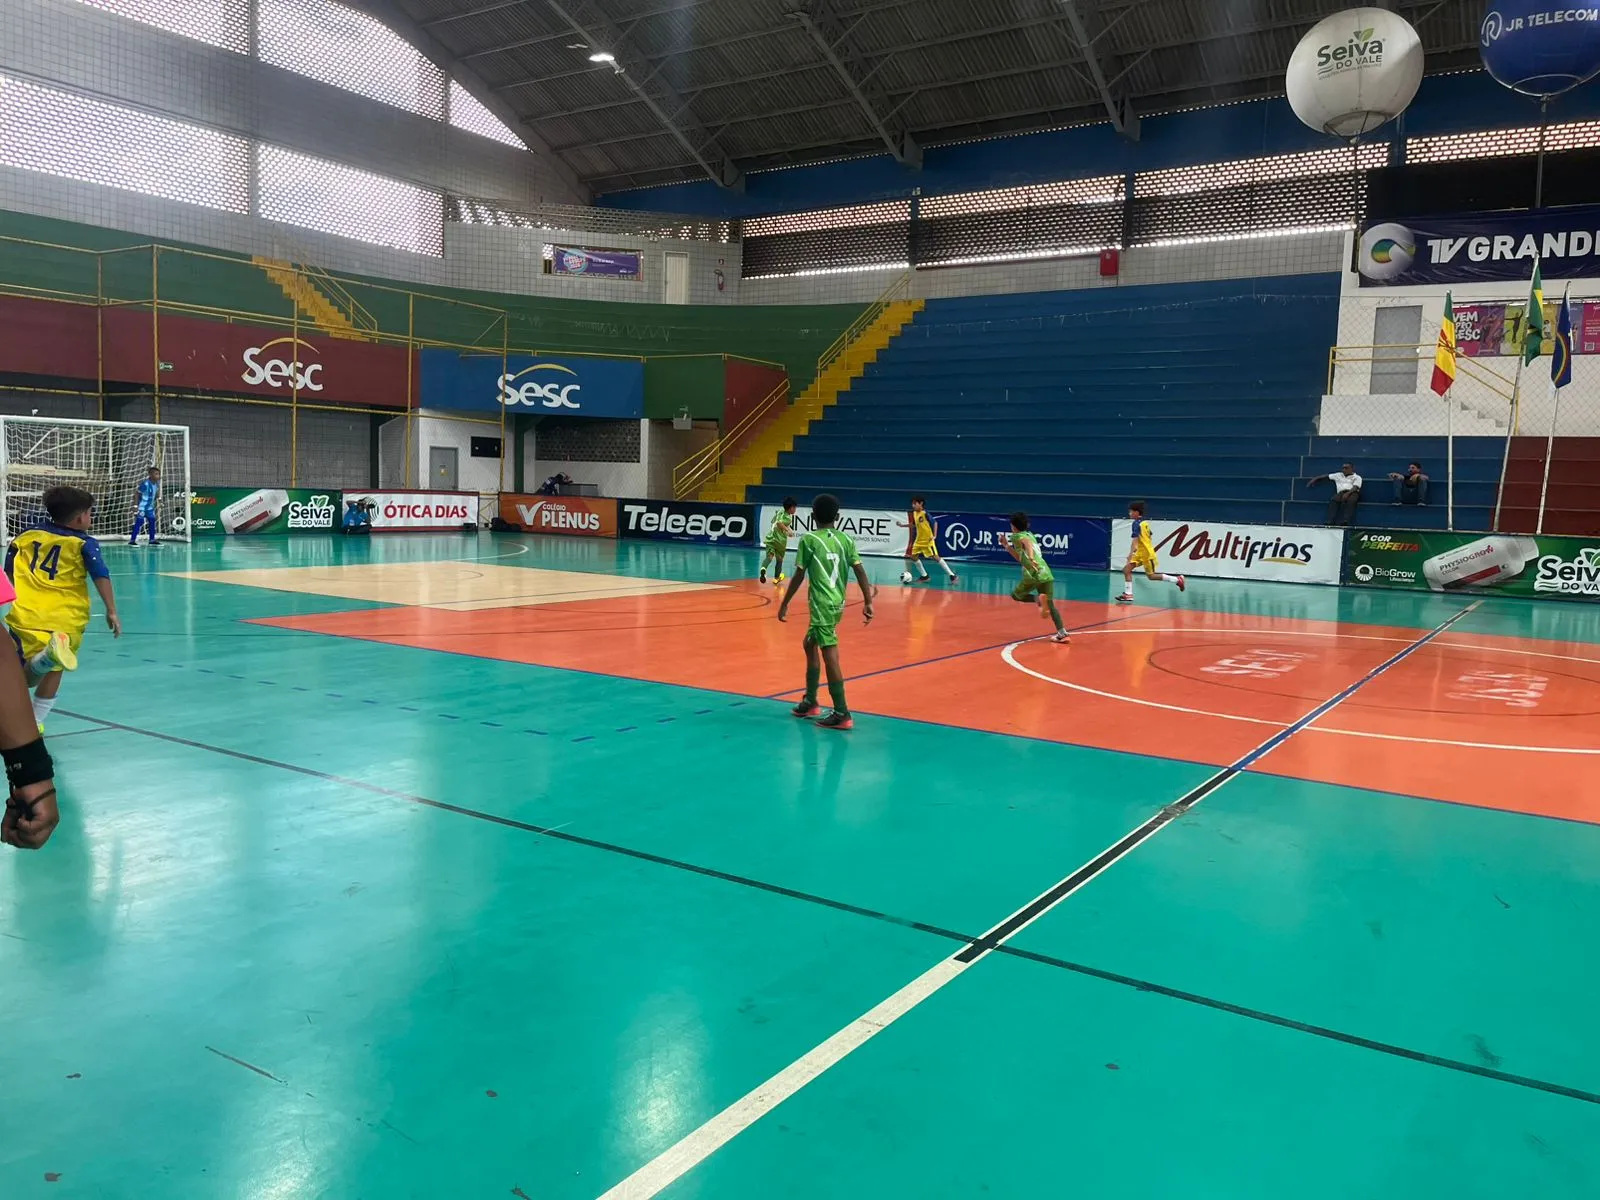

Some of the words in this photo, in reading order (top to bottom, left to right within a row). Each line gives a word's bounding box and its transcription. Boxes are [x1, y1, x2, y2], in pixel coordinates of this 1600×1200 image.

[1505, 18, 1524, 32] JR
[1527, 9, 1599, 28] TELECOM
[1317, 38, 1383, 67] Seiva
[1336, 59, 1353, 70] DO
[1356, 54, 1383, 65] VALE
[1452, 311, 1478, 323] VEM
[1455, 329, 1481, 341] ESC
[241, 347, 324, 392] Sesc
[496, 374, 581, 410] Sesc
[290, 503, 332, 520] Seiva
[384, 500, 434, 519] ÓTICA
[435, 504, 468, 519] DIAS
[542, 502, 567, 511] COLÉGIO
[541, 511, 600, 530] PLENUS
[623, 504, 748, 541] Teleaço
[973, 530, 993, 545] JR
[996, 532, 1069, 549] TECOM
[1154, 523, 1314, 568] Multifrios
[1360, 534, 1369, 542] A
[1370, 535, 1392, 543] COR
[1361, 541, 1421, 552] PERFEITA
[30, 540, 62, 580] 14
[1439, 544, 1495, 572] PHYSIOGROW
[826, 552, 841, 589] 7
[1375, 567, 1417, 579] BioGrow
[1540, 557, 1600, 582] Seiv
[1561, 582, 1580, 590] DO
